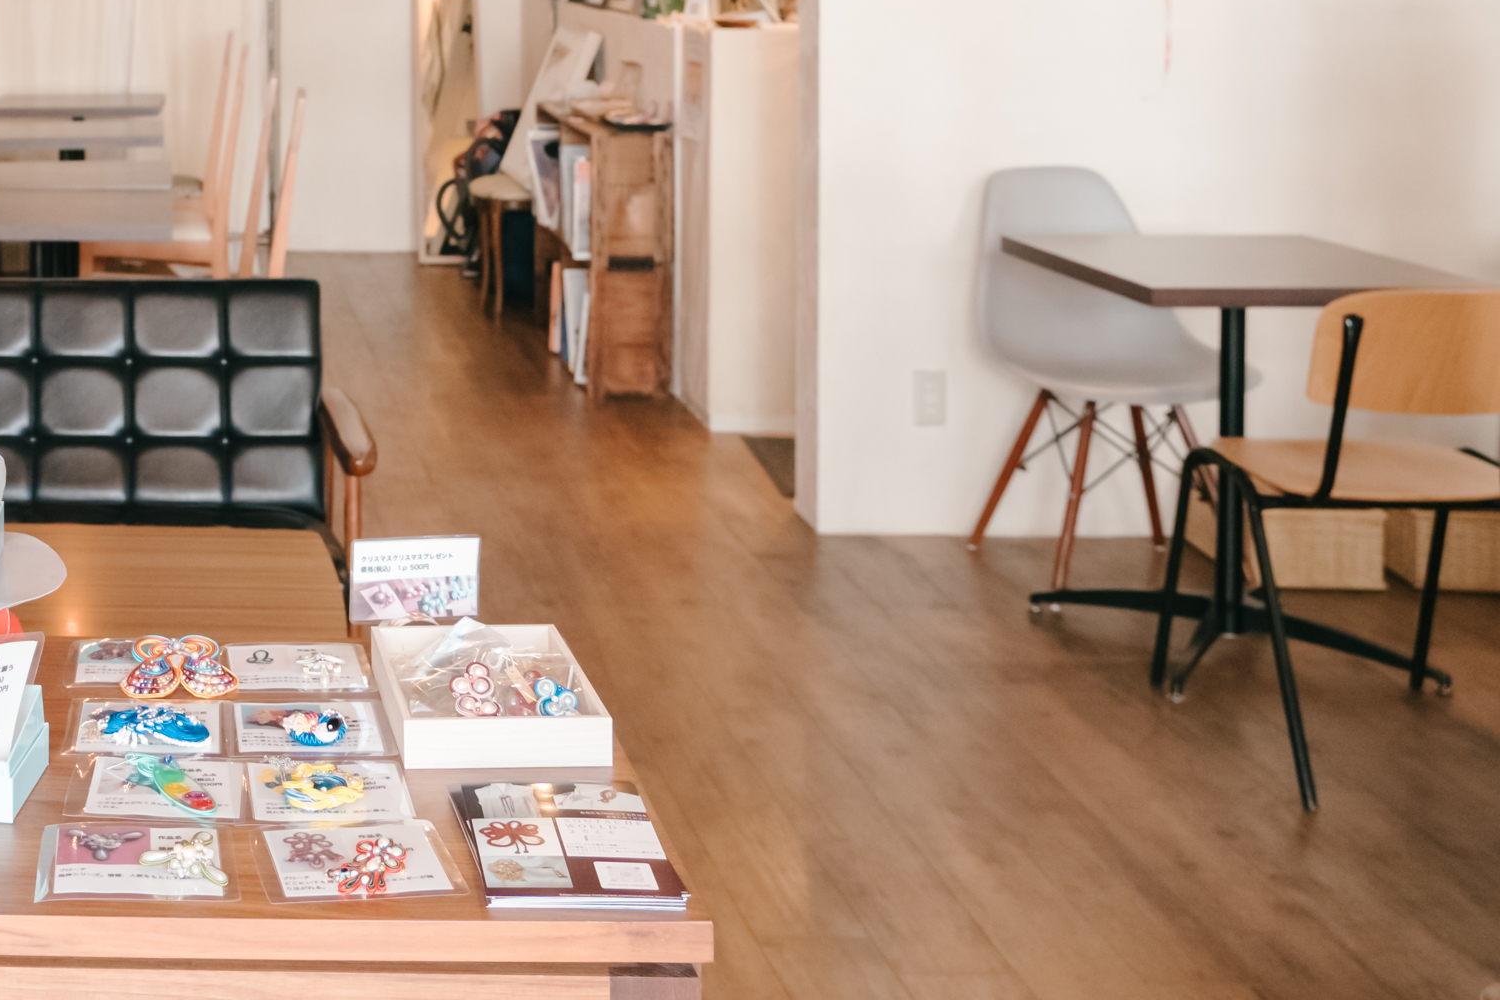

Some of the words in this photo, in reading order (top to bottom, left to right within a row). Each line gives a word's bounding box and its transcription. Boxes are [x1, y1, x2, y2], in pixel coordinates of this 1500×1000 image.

[361, 553, 453, 562] クリスマスクリスマスプレゼント
[361, 565, 391, 573] 価格(税込)
